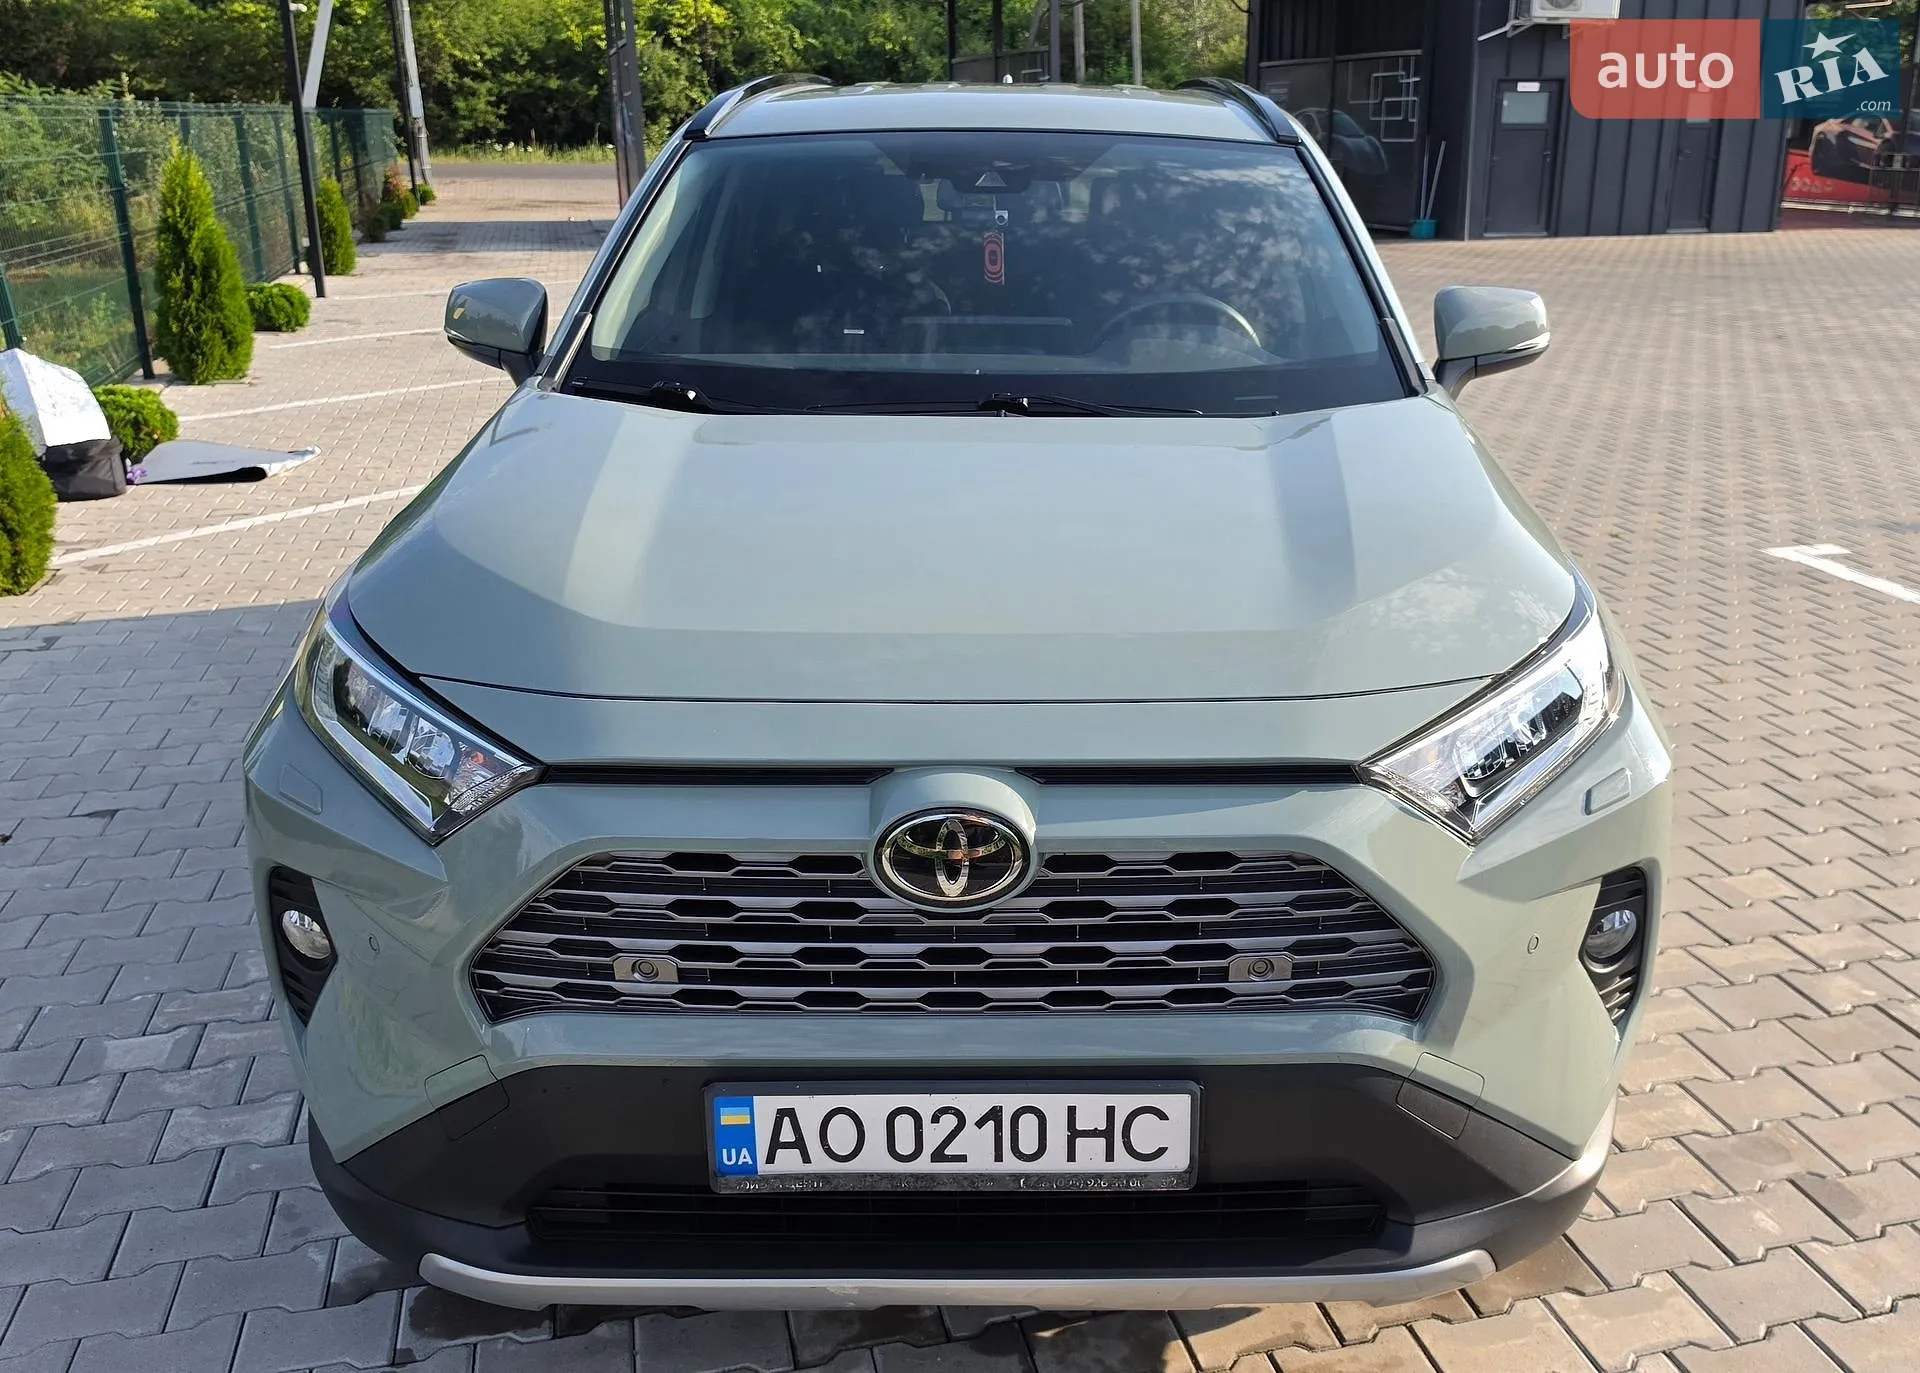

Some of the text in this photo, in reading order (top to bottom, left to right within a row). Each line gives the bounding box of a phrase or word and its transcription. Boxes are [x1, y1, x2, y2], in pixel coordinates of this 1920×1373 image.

[764, 1105, 1170, 1165] AO 0210 HC
[722, 1148, 753, 1165] UA
